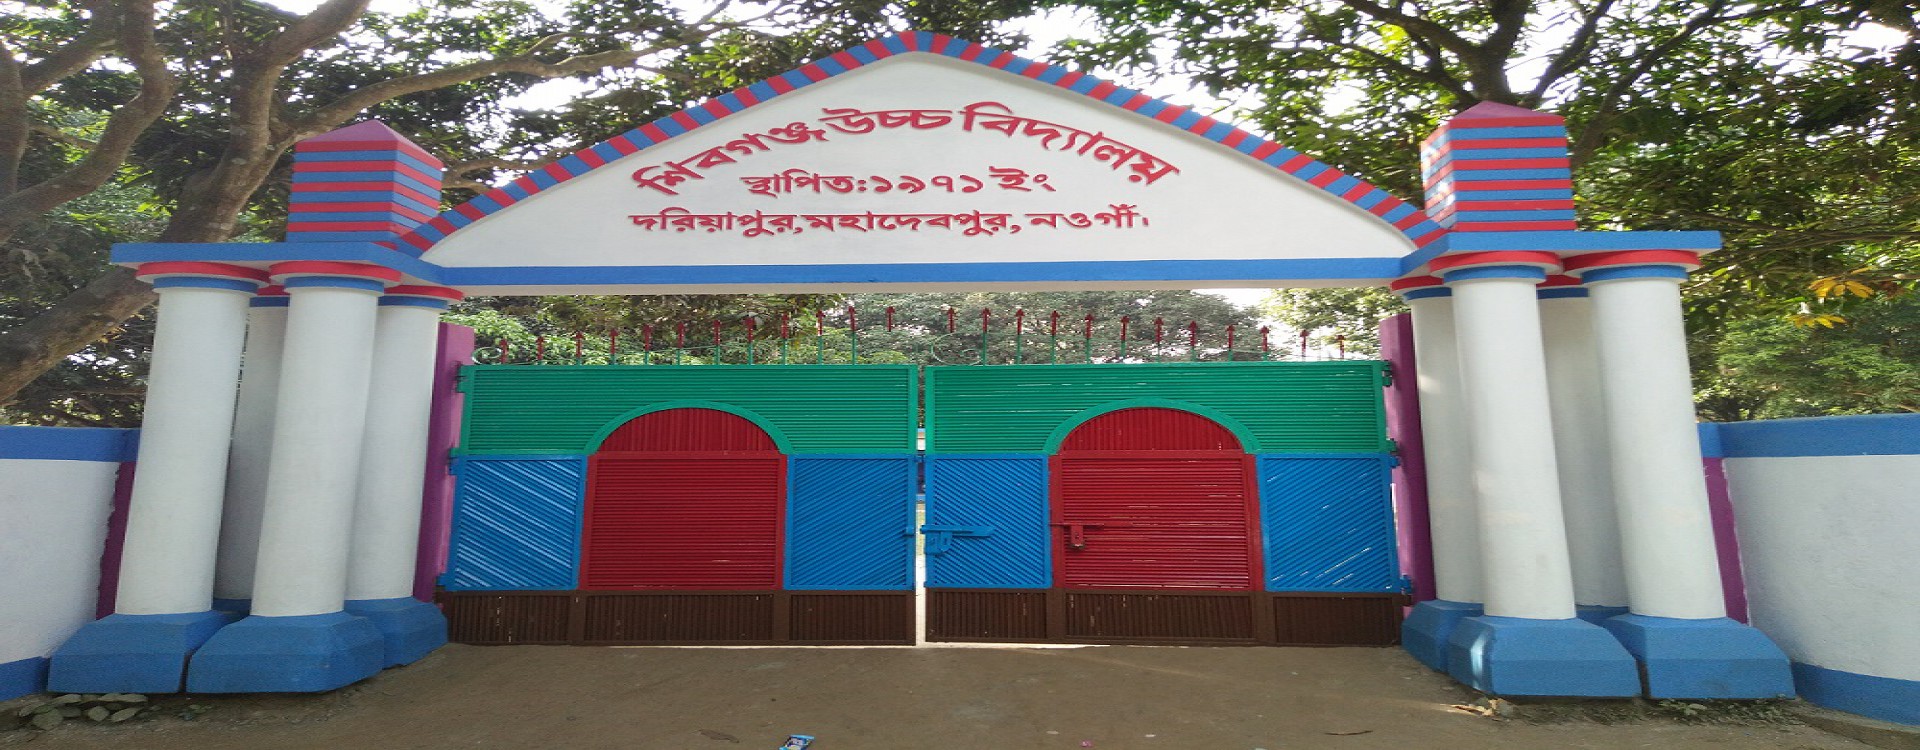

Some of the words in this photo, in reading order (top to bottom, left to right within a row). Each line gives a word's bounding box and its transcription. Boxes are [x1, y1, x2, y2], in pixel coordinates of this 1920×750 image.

[631, 121, 830, 196] শিবগঞ্জ
[818, 107, 953, 135] উচ্চ
[959, 100, 1181, 185] বিদ্যালয়
